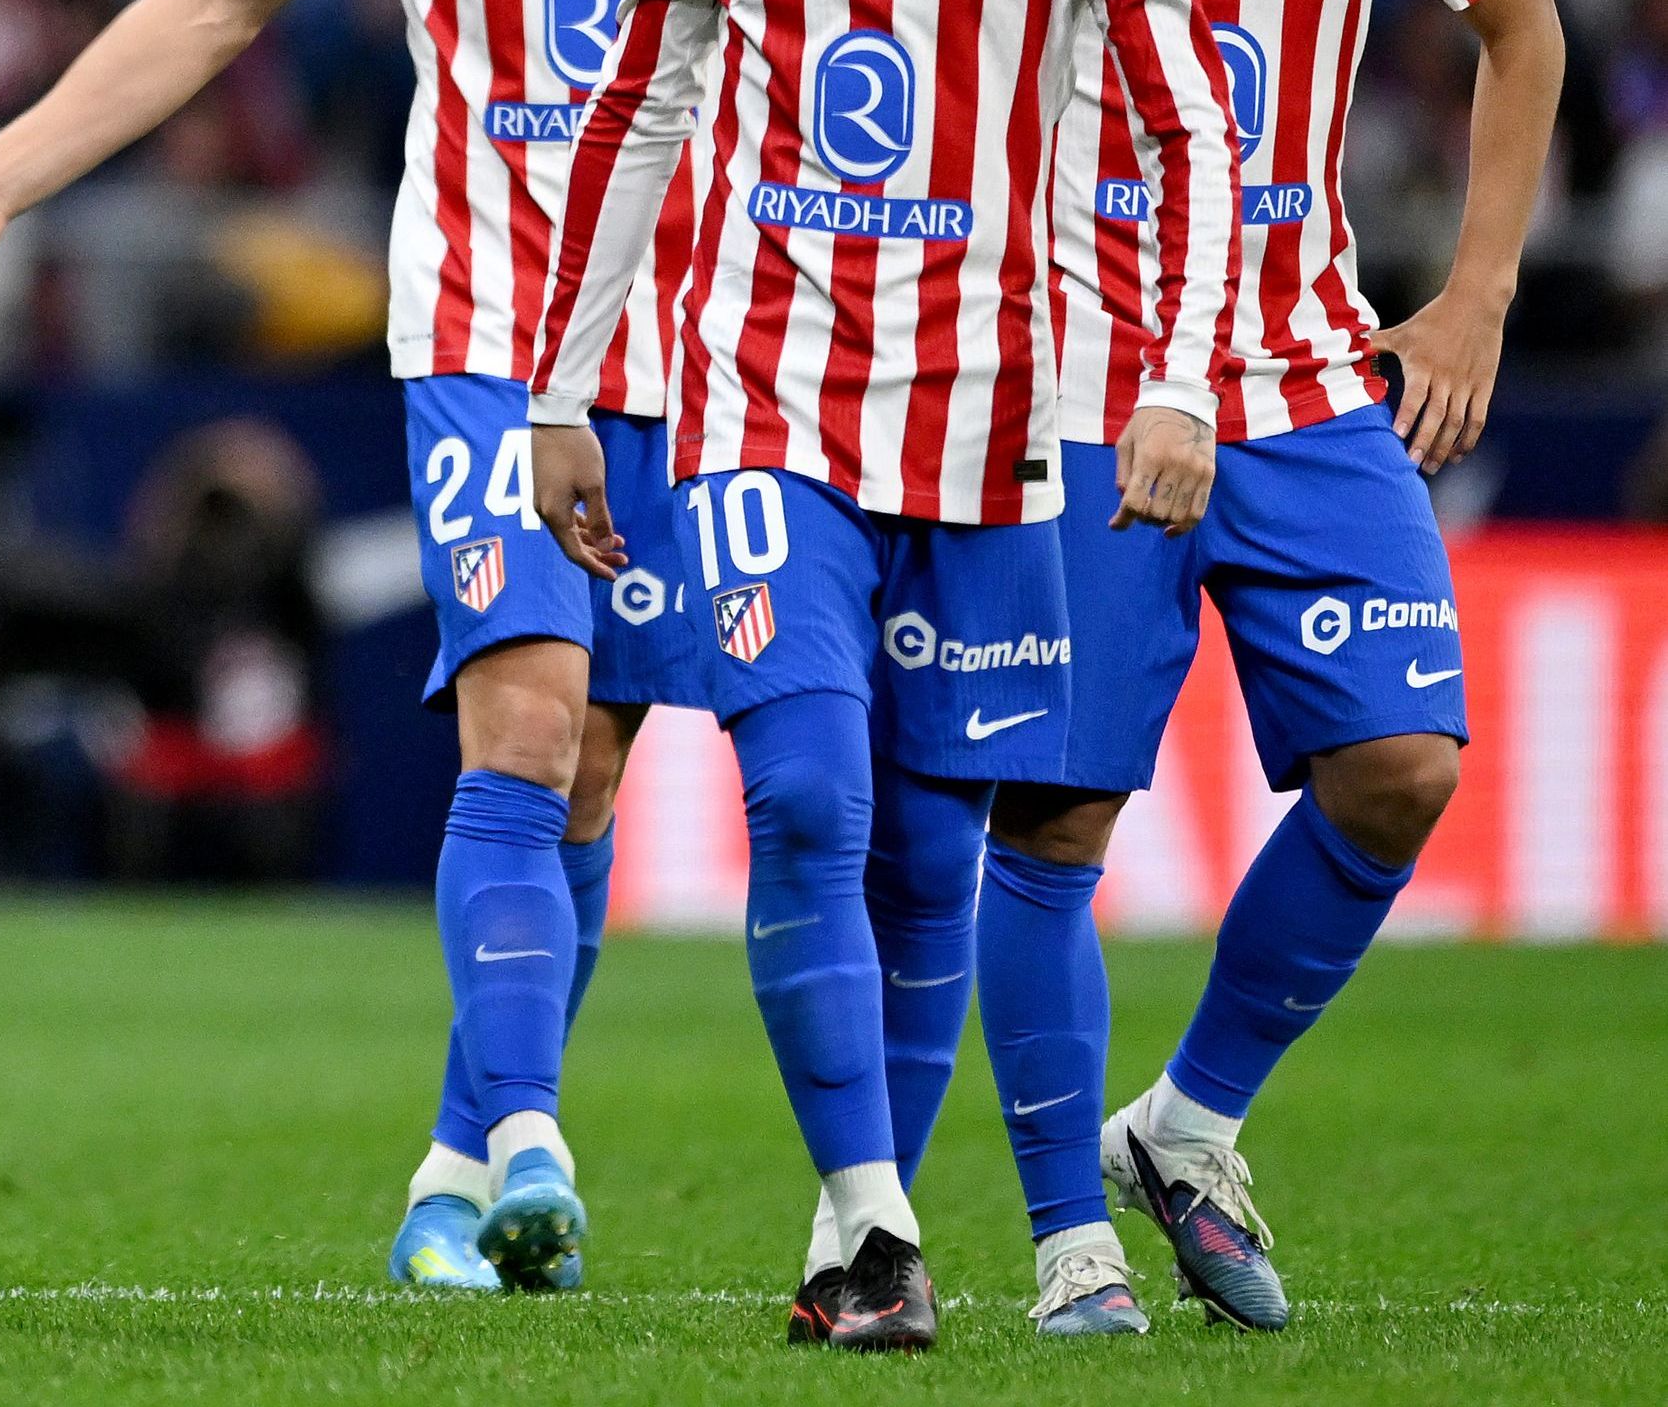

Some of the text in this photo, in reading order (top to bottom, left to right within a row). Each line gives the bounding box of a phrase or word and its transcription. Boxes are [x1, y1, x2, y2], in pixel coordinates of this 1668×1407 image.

[493, 106, 584, 137] RIYA
[755, 186, 963, 237] RIYADH AIR
[1252, 188, 1305, 220] AIR
[425, 429, 541, 545] 24
[686, 470, 789, 590] 10
